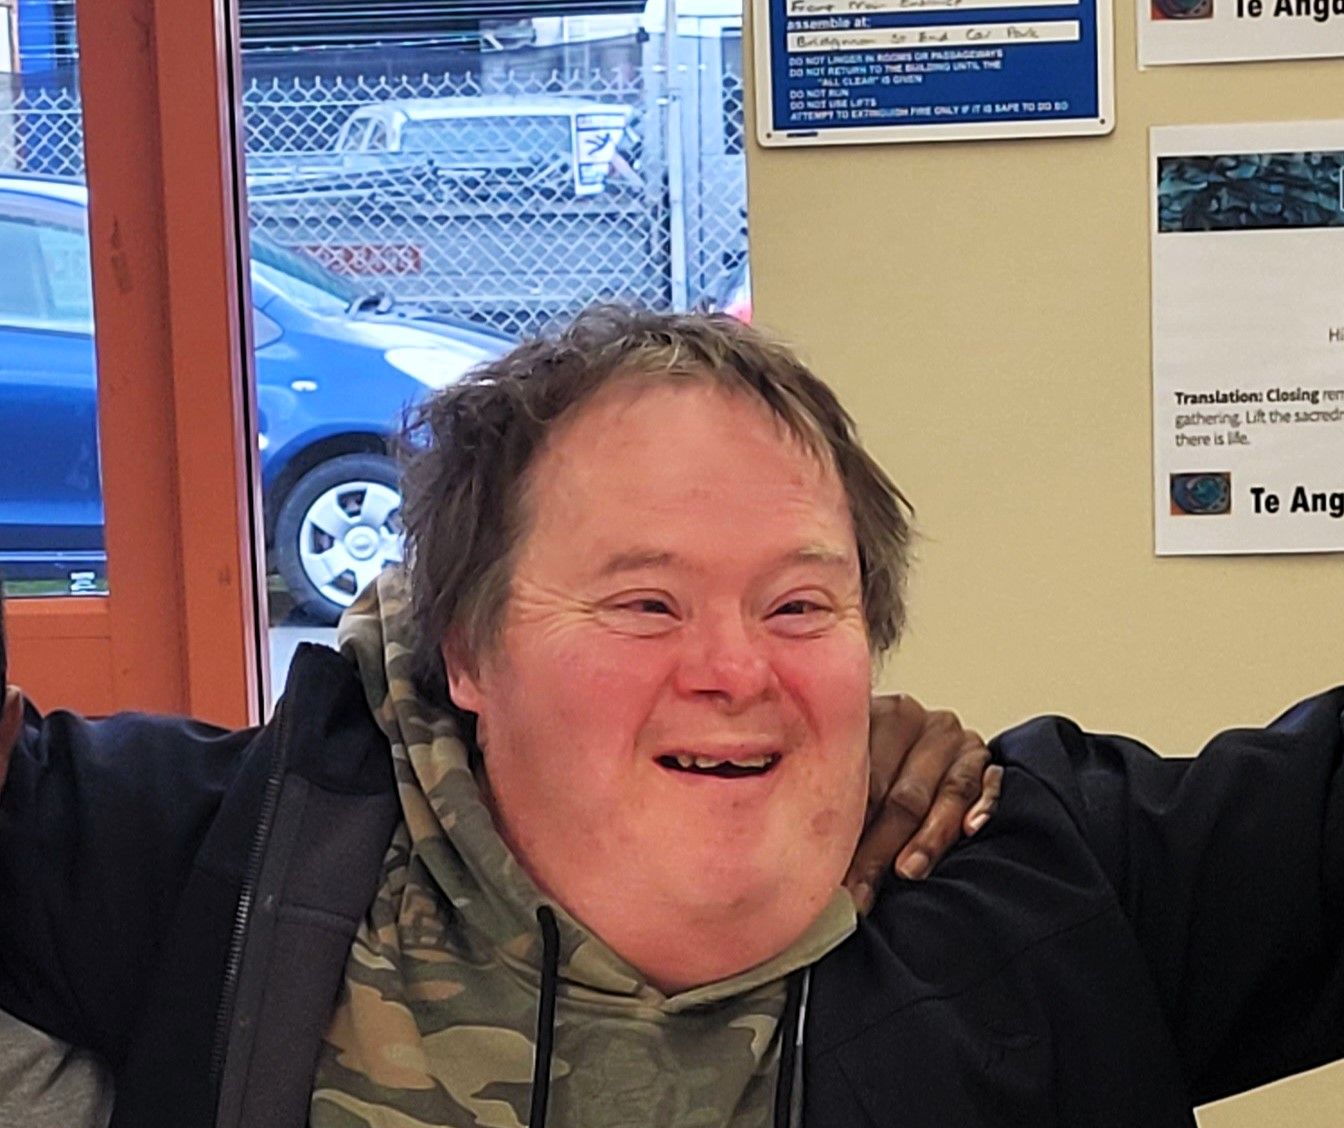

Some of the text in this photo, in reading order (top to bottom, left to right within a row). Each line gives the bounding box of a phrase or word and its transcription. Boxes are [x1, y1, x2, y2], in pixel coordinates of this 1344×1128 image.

[787, 16, 872, 31] assemble at:
[1007, 26, 1039, 39] Park
[788, 53, 912, 67] DO NOT LINGER ROOMS
[788, 60, 1002, 78] DO NOT RETURN TO THE BUILDING UNTIL THE
[892, 74, 923, 85] GIVEN
[789, 88, 850, 99] DO NOT RUN
[789, 98, 878, 110] DO NOT USE LIFTS
[790, 110, 834, 121] ATTEMPT
[836, 109, 850, 119] TO
[910, 106, 932, 116] FIRE
[933, 105, 959, 116] ONLY
[994, 102, 1020, 113] SAFE
[1021, 102, 1036, 112] TO
[1174, 388, 1264, 405] Translation:
[1265, 387, 1320, 405] Closing
[1174, 412, 1242, 430] gathering.
[1245, 410, 1267, 425] Lift
[1269, 409, 1291, 424] the
[1174, 431, 1211, 448] there
[1213, 431, 1225, 446] is
[1250, 486, 1280, 514] Te
